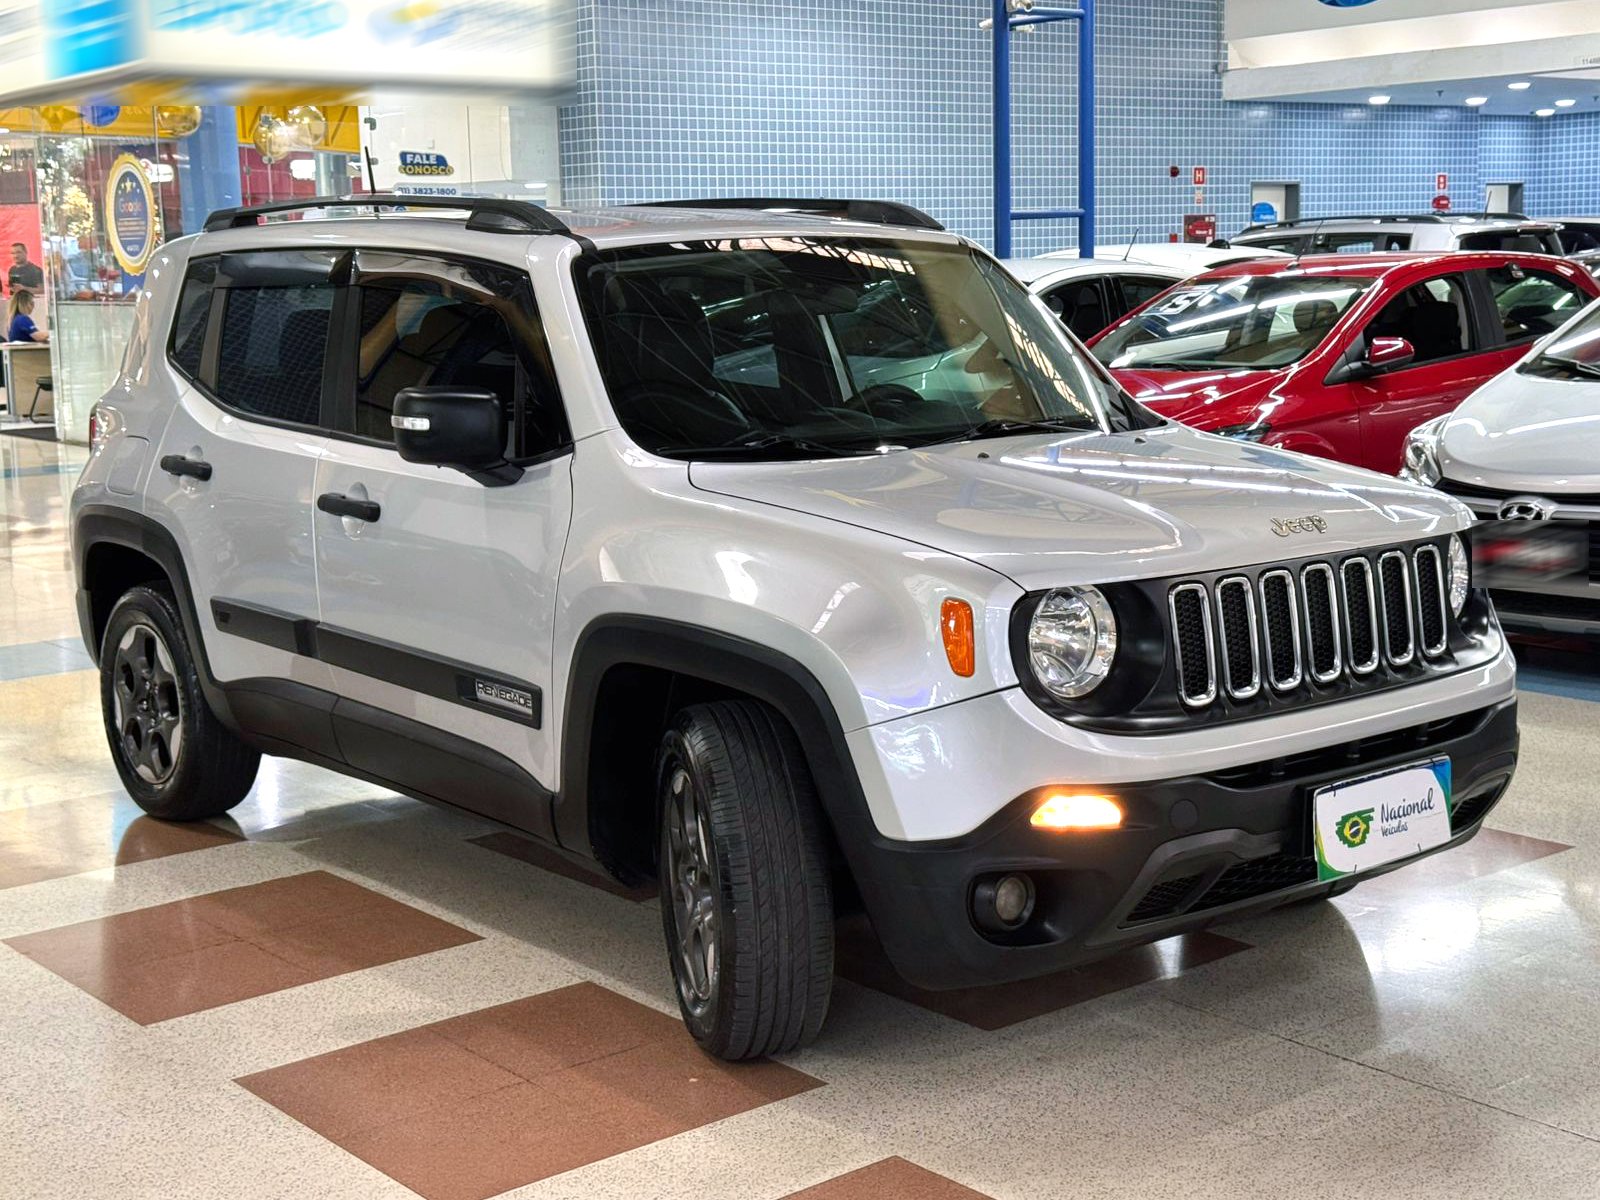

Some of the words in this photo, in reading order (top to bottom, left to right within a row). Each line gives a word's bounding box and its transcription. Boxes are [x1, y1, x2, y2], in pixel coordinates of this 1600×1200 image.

[406, 154, 437, 165] FALE
[399, 164, 455, 175] CONOSCO
[1195, 170, 1204, 182] H
[412, 187, 456, 197] 3823-1800
[1270, 515, 1328, 538] Jeep
[477, 681, 533, 708] RENEGADE
[1381, 787, 1435, 823] Nacional
